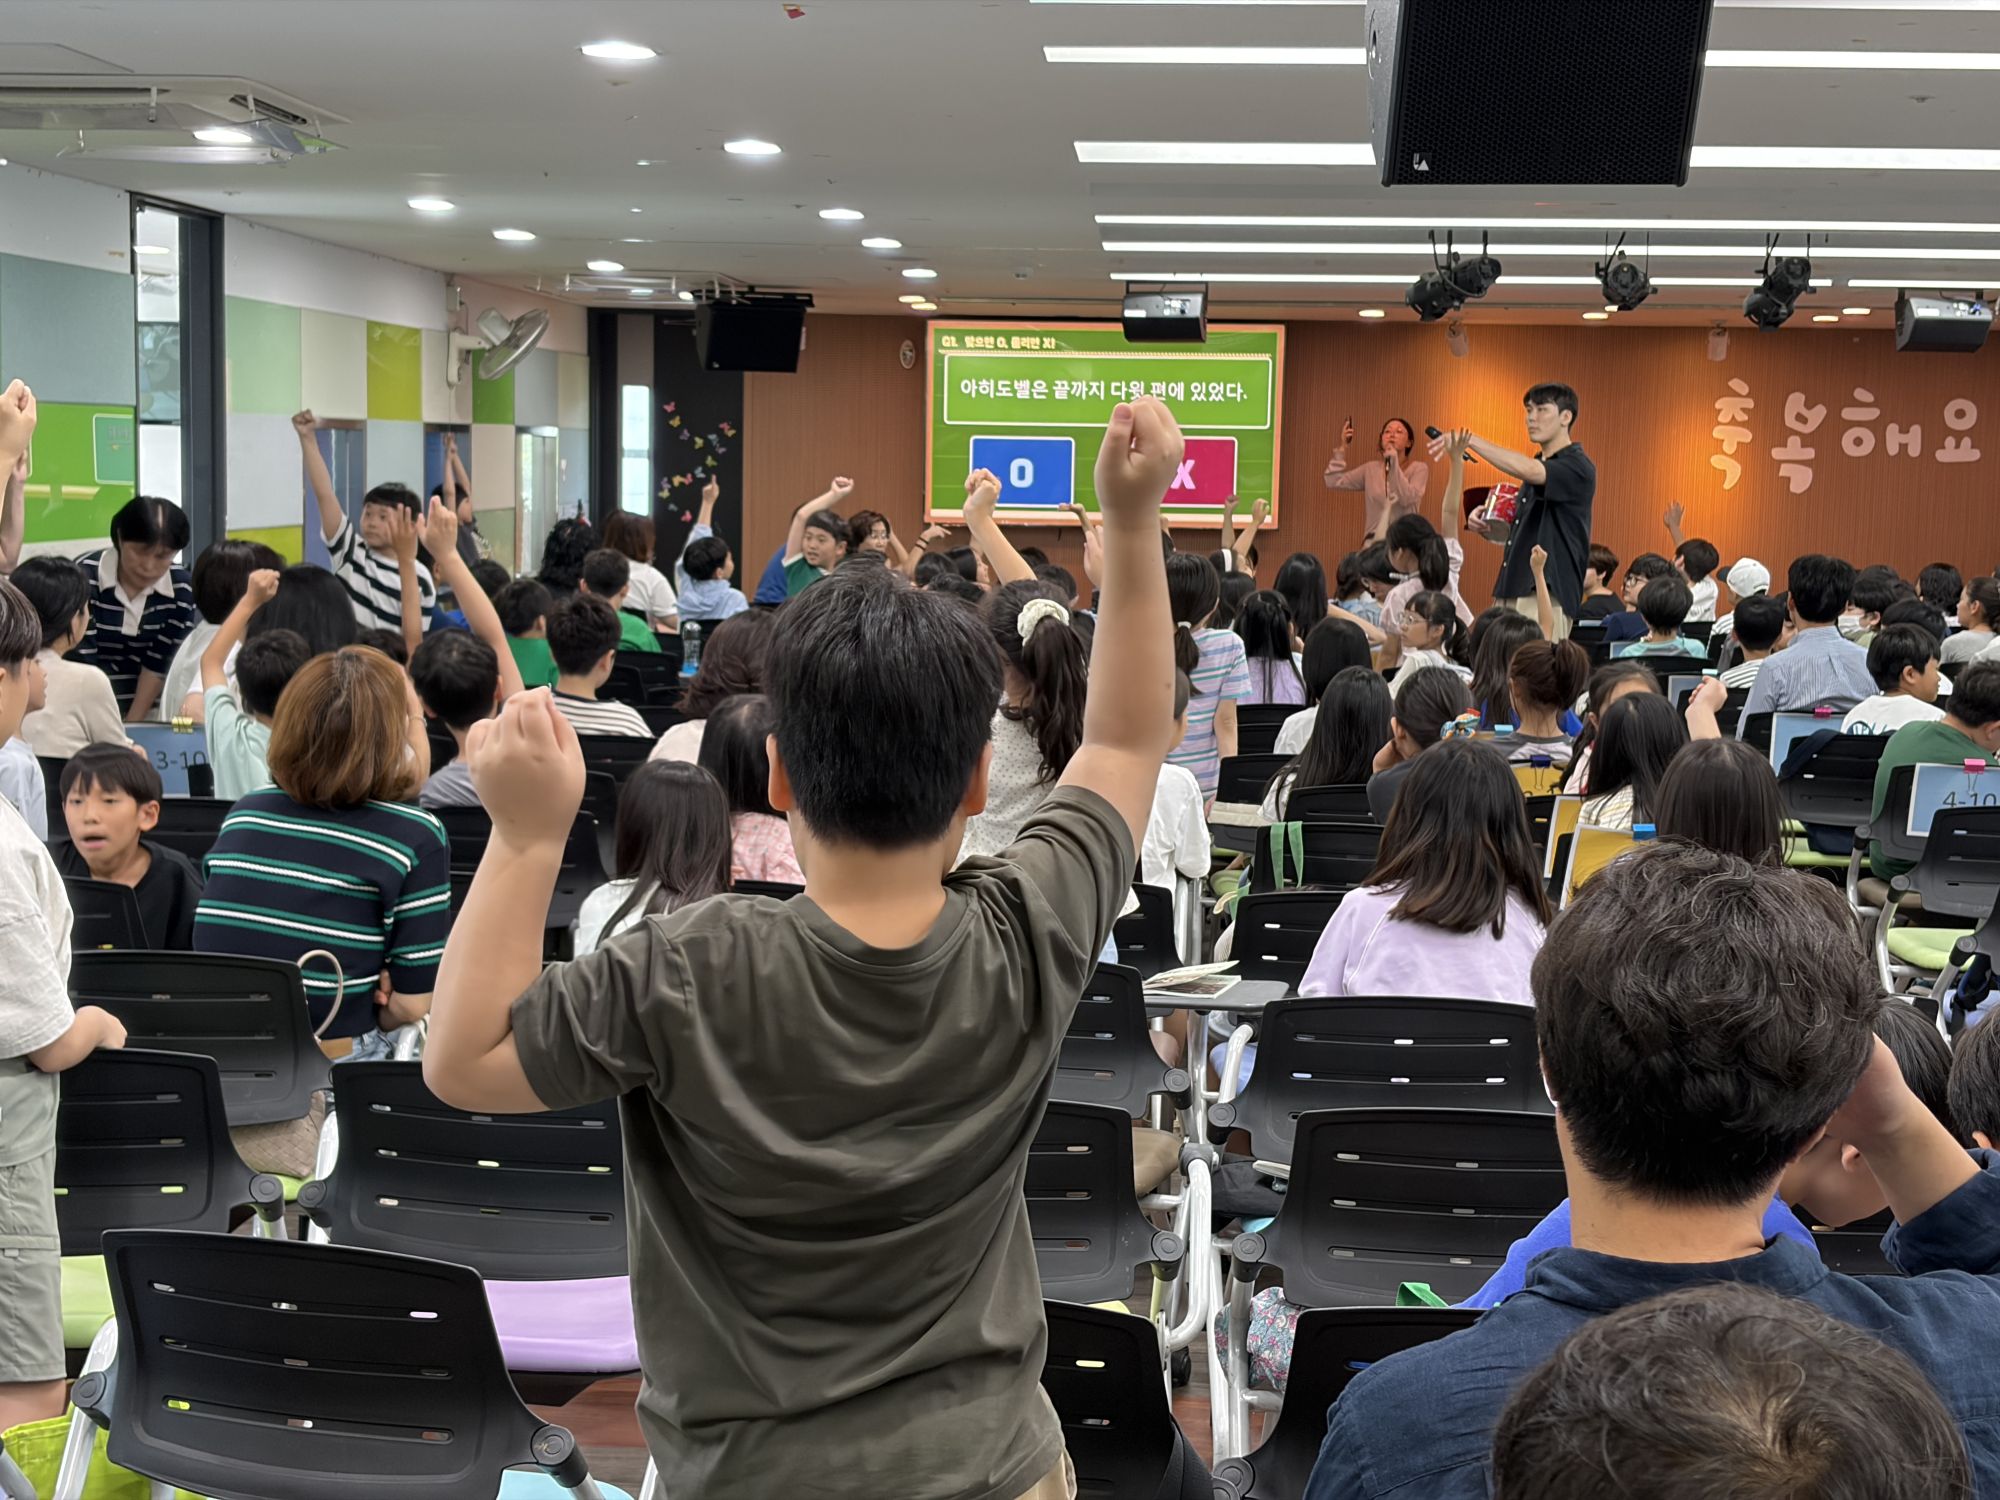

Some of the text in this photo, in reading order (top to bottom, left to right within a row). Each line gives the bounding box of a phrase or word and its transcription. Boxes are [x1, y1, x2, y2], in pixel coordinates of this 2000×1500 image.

[964, 336, 995, 348] 맞으면
[1011, 336, 1040, 349] 틀리면
[960, 378, 1248, 402] 아히도벨은 끝까지 다윗 편에 있었다.
[1170, 459, 1196, 489] X
[156, 751, 207, 770] 3-10
[1942, 791, 1997, 808] 4-10
